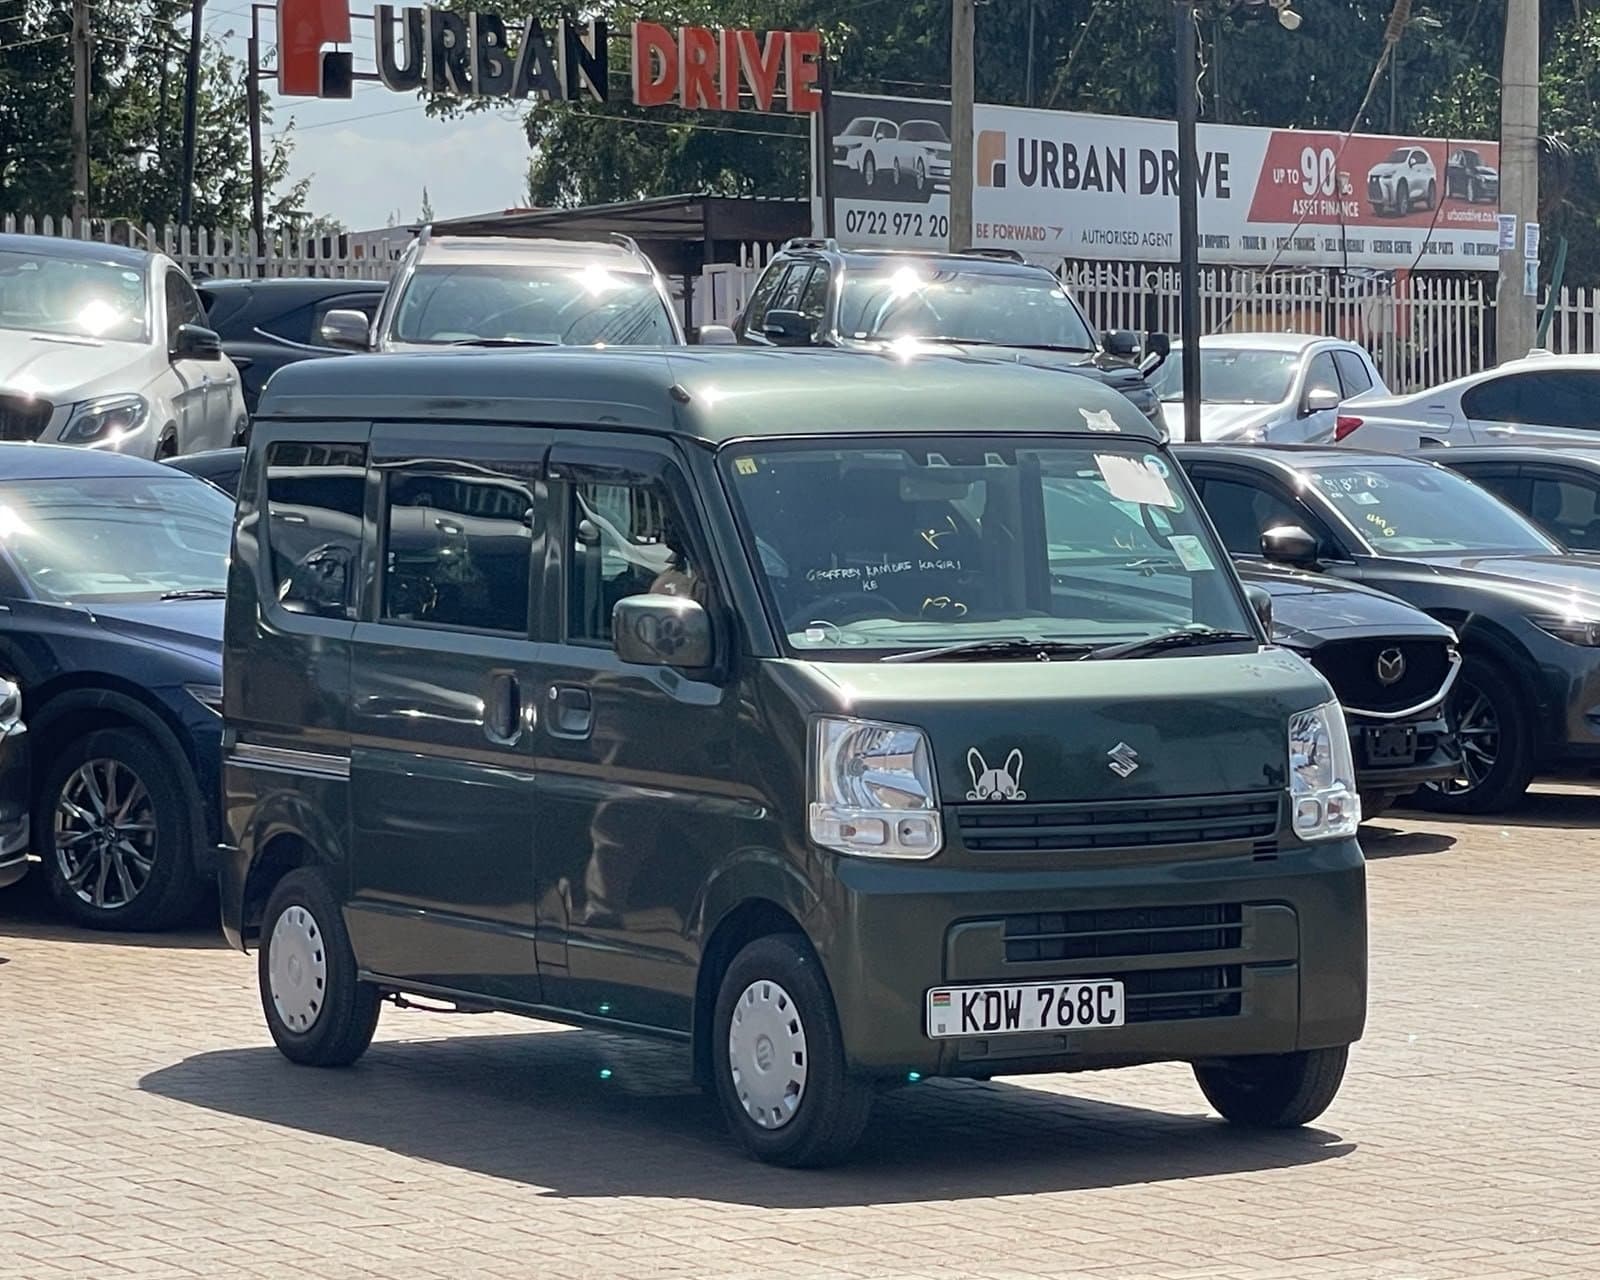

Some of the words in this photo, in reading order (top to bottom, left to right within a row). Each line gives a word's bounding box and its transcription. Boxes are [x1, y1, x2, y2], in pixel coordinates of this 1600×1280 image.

[375, 4, 608, 101] URBAN
[631, 21, 821, 112] DRIVE
[1018, 137, 1127, 193] URBAN
[1139, 148, 1231, 199] DRVE
[1287, 168, 1300, 185] TO
[1292, 199, 1319, 216] ASSET
[1320, 200, 1359, 218] FINANCE
[846, 209, 887, 236] 0722
[892, 212, 923, 237] 972
[929, 214, 949, 238] 20
[976, 223, 989, 239] BE
[992, 224, 1047, 241] FORWARD
[1081, 228, 1140, 246] AUTHORISED
[1142, 232, 1173, 248] AGENT
[962, 988, 1022, 1032] KDW
[1037, 984, 1117, 1028] 768C
